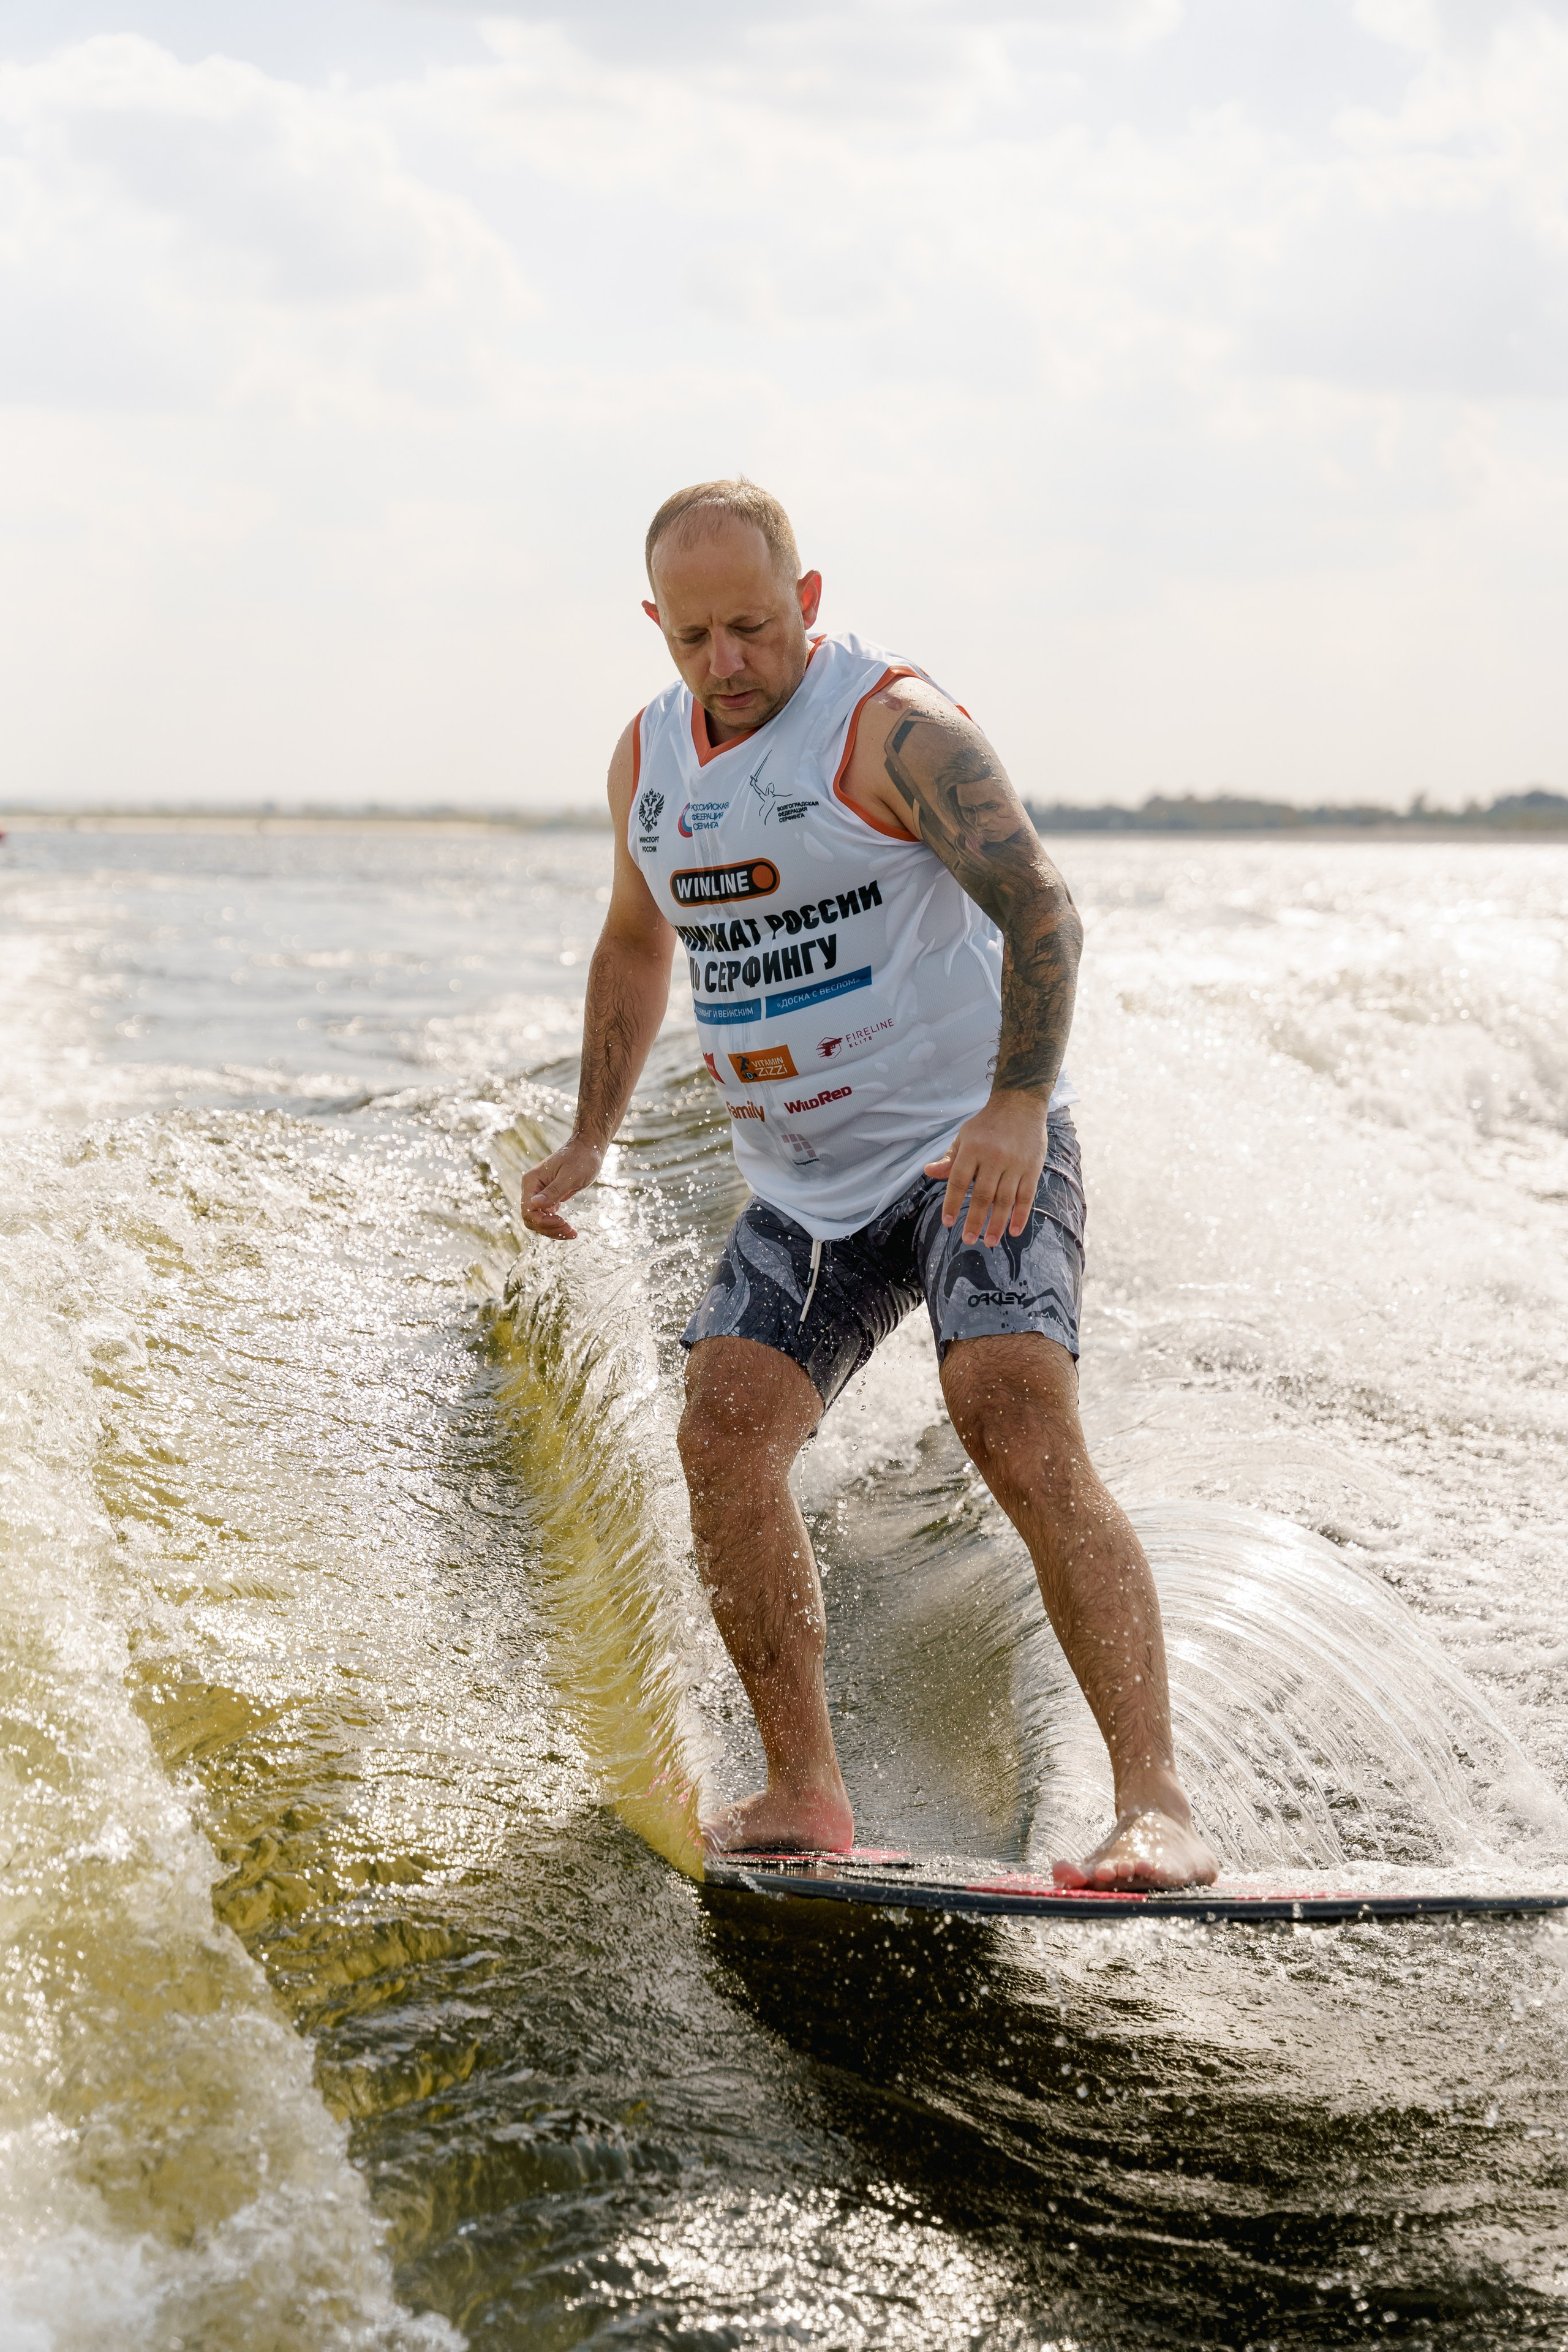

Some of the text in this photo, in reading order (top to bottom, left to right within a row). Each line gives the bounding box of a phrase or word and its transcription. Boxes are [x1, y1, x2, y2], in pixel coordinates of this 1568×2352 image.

[777, 801, 820, 812] ВОЛГОГРАДСКАЯ
[778, 807, 808, 817] ФЕДЕРАЦИЯ
[778, 813, 805, 823] СЕРФИНГА
[676, 870, 750, 899] WINLINE
[763, 880, 883, 940] РОССИИ
[704, 933, 837, 993] СЕРФИНГУ
[845, 1018, 894, 1042] FIRELINE
[849, 1036, 872, 1048] ELITE
[751, 1057, 784, 1068] VITAMIN
[726, 1100, 765, 1122] Family
[968, 1292, 1027, 1308] OAKLEY
